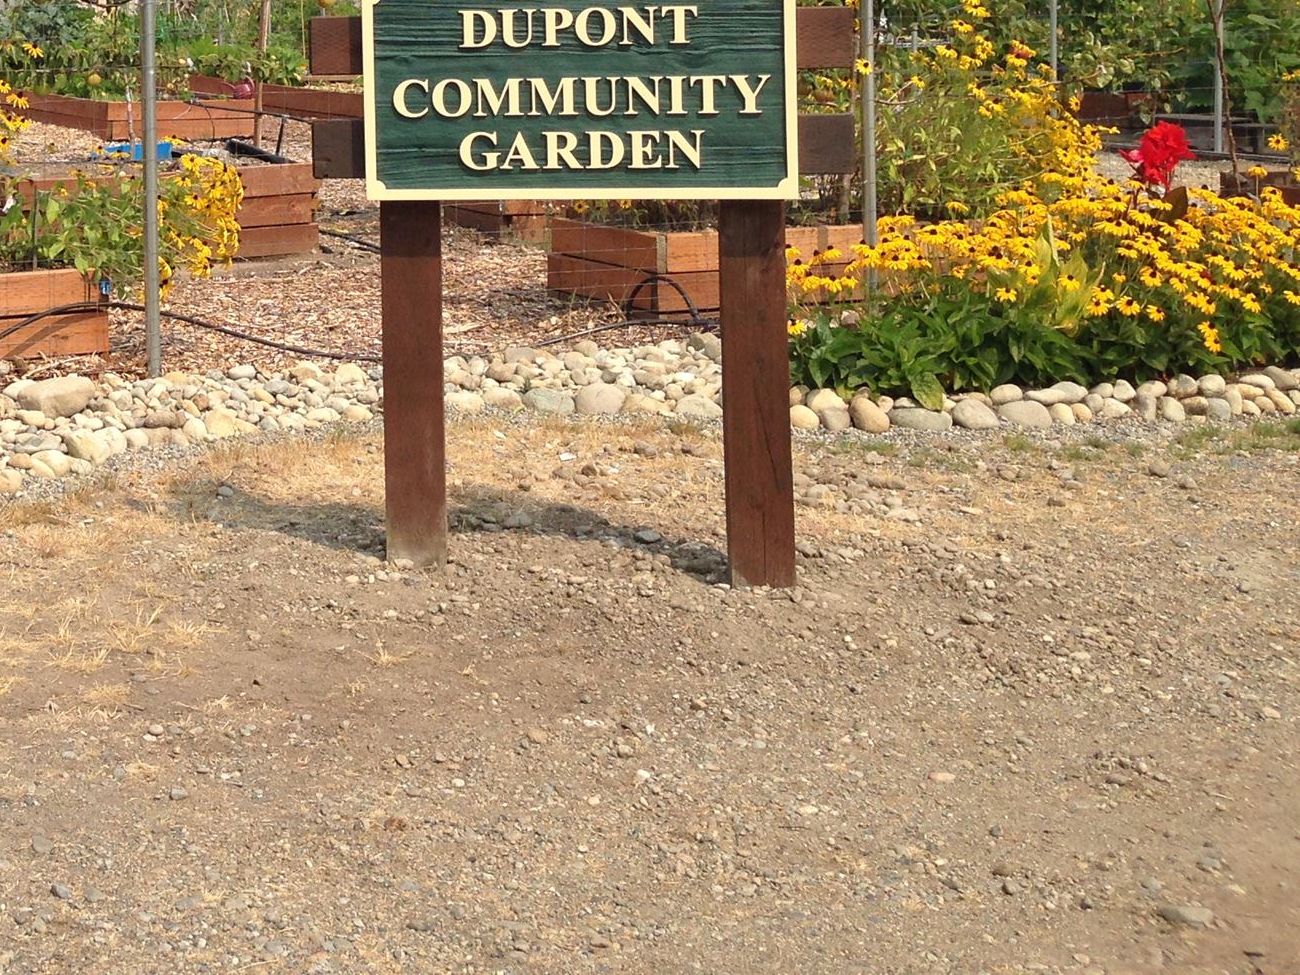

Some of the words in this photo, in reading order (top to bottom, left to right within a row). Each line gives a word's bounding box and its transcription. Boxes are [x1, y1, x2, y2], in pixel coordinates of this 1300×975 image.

[458, 5, 698, 49] DUPONT
[392, 74, 772, 119] COMMUNITY
[458, 129, 706, 172] GARDEN
